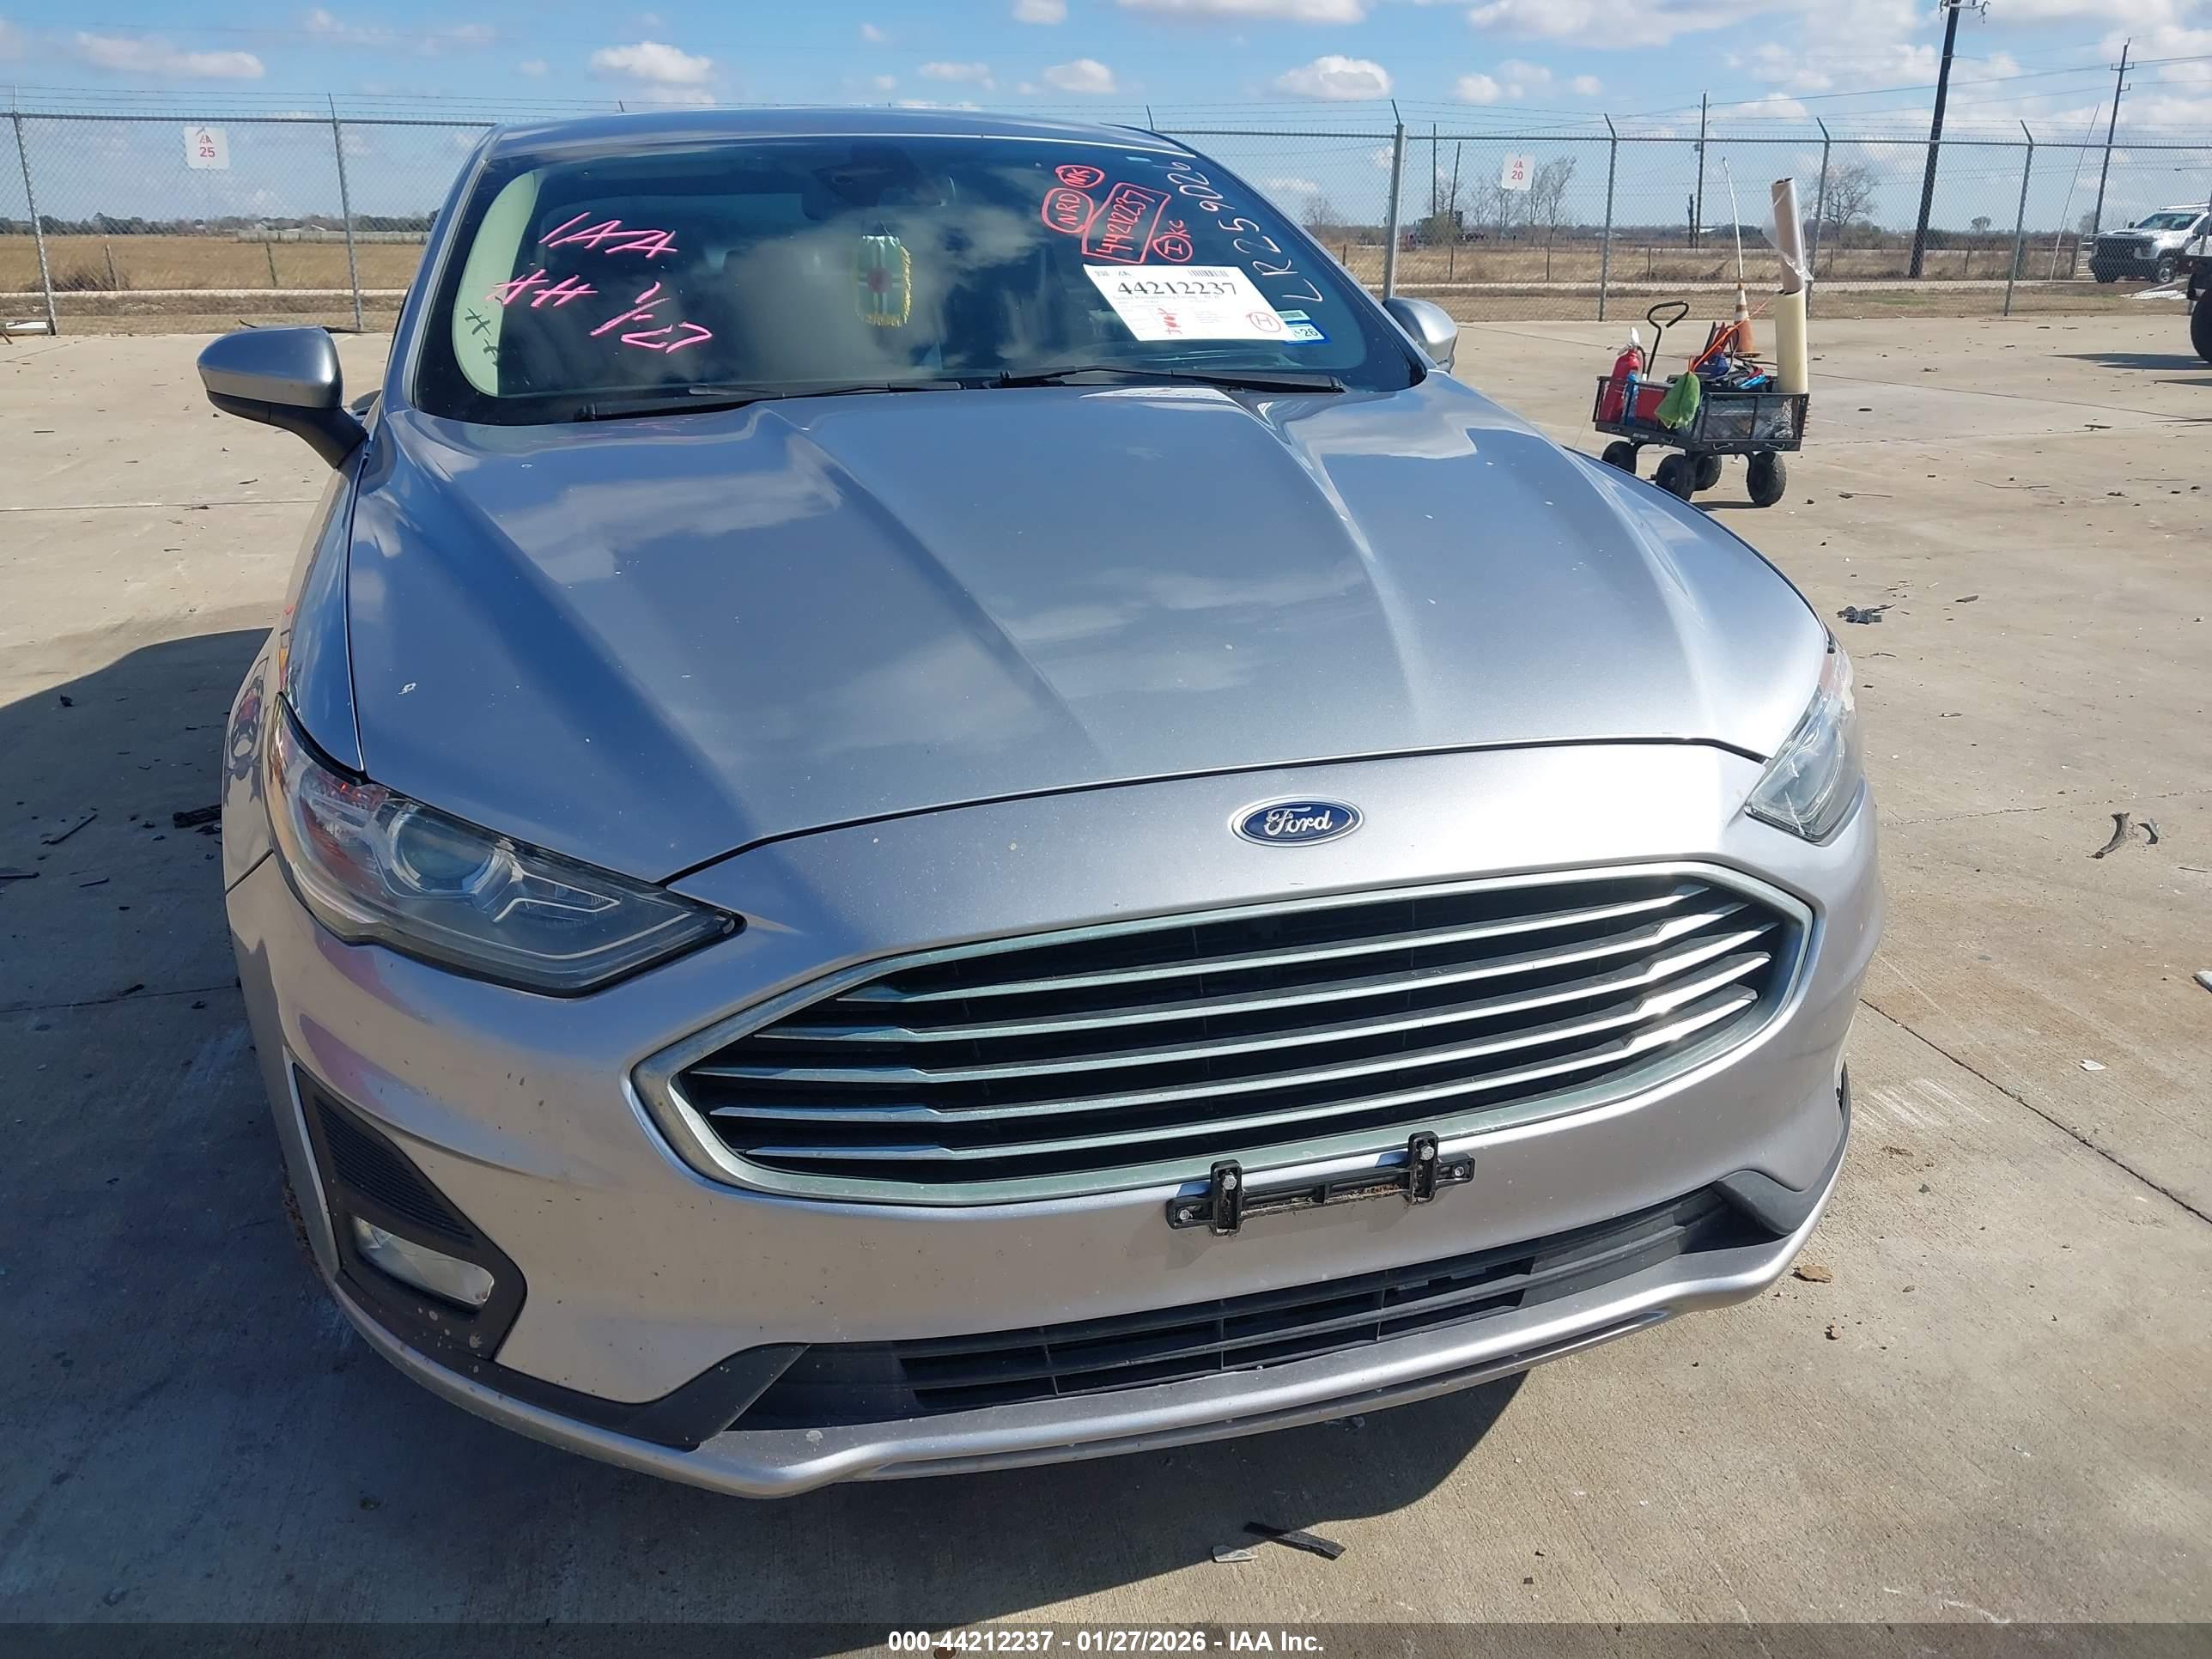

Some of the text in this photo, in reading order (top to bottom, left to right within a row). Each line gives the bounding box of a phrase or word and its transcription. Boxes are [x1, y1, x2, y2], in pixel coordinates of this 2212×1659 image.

[199, 146, 216, 158] 25
[1511, 170, 1524, 180] 20
[1055, 192, 1081, 226] NRD
[1096, 189, 1156, 254] 44212237
[1117, 281, 1237, 295] 44212237
[1299, 328, 1319, 337] 26
[1264, 806, 1333, 836] Ford
